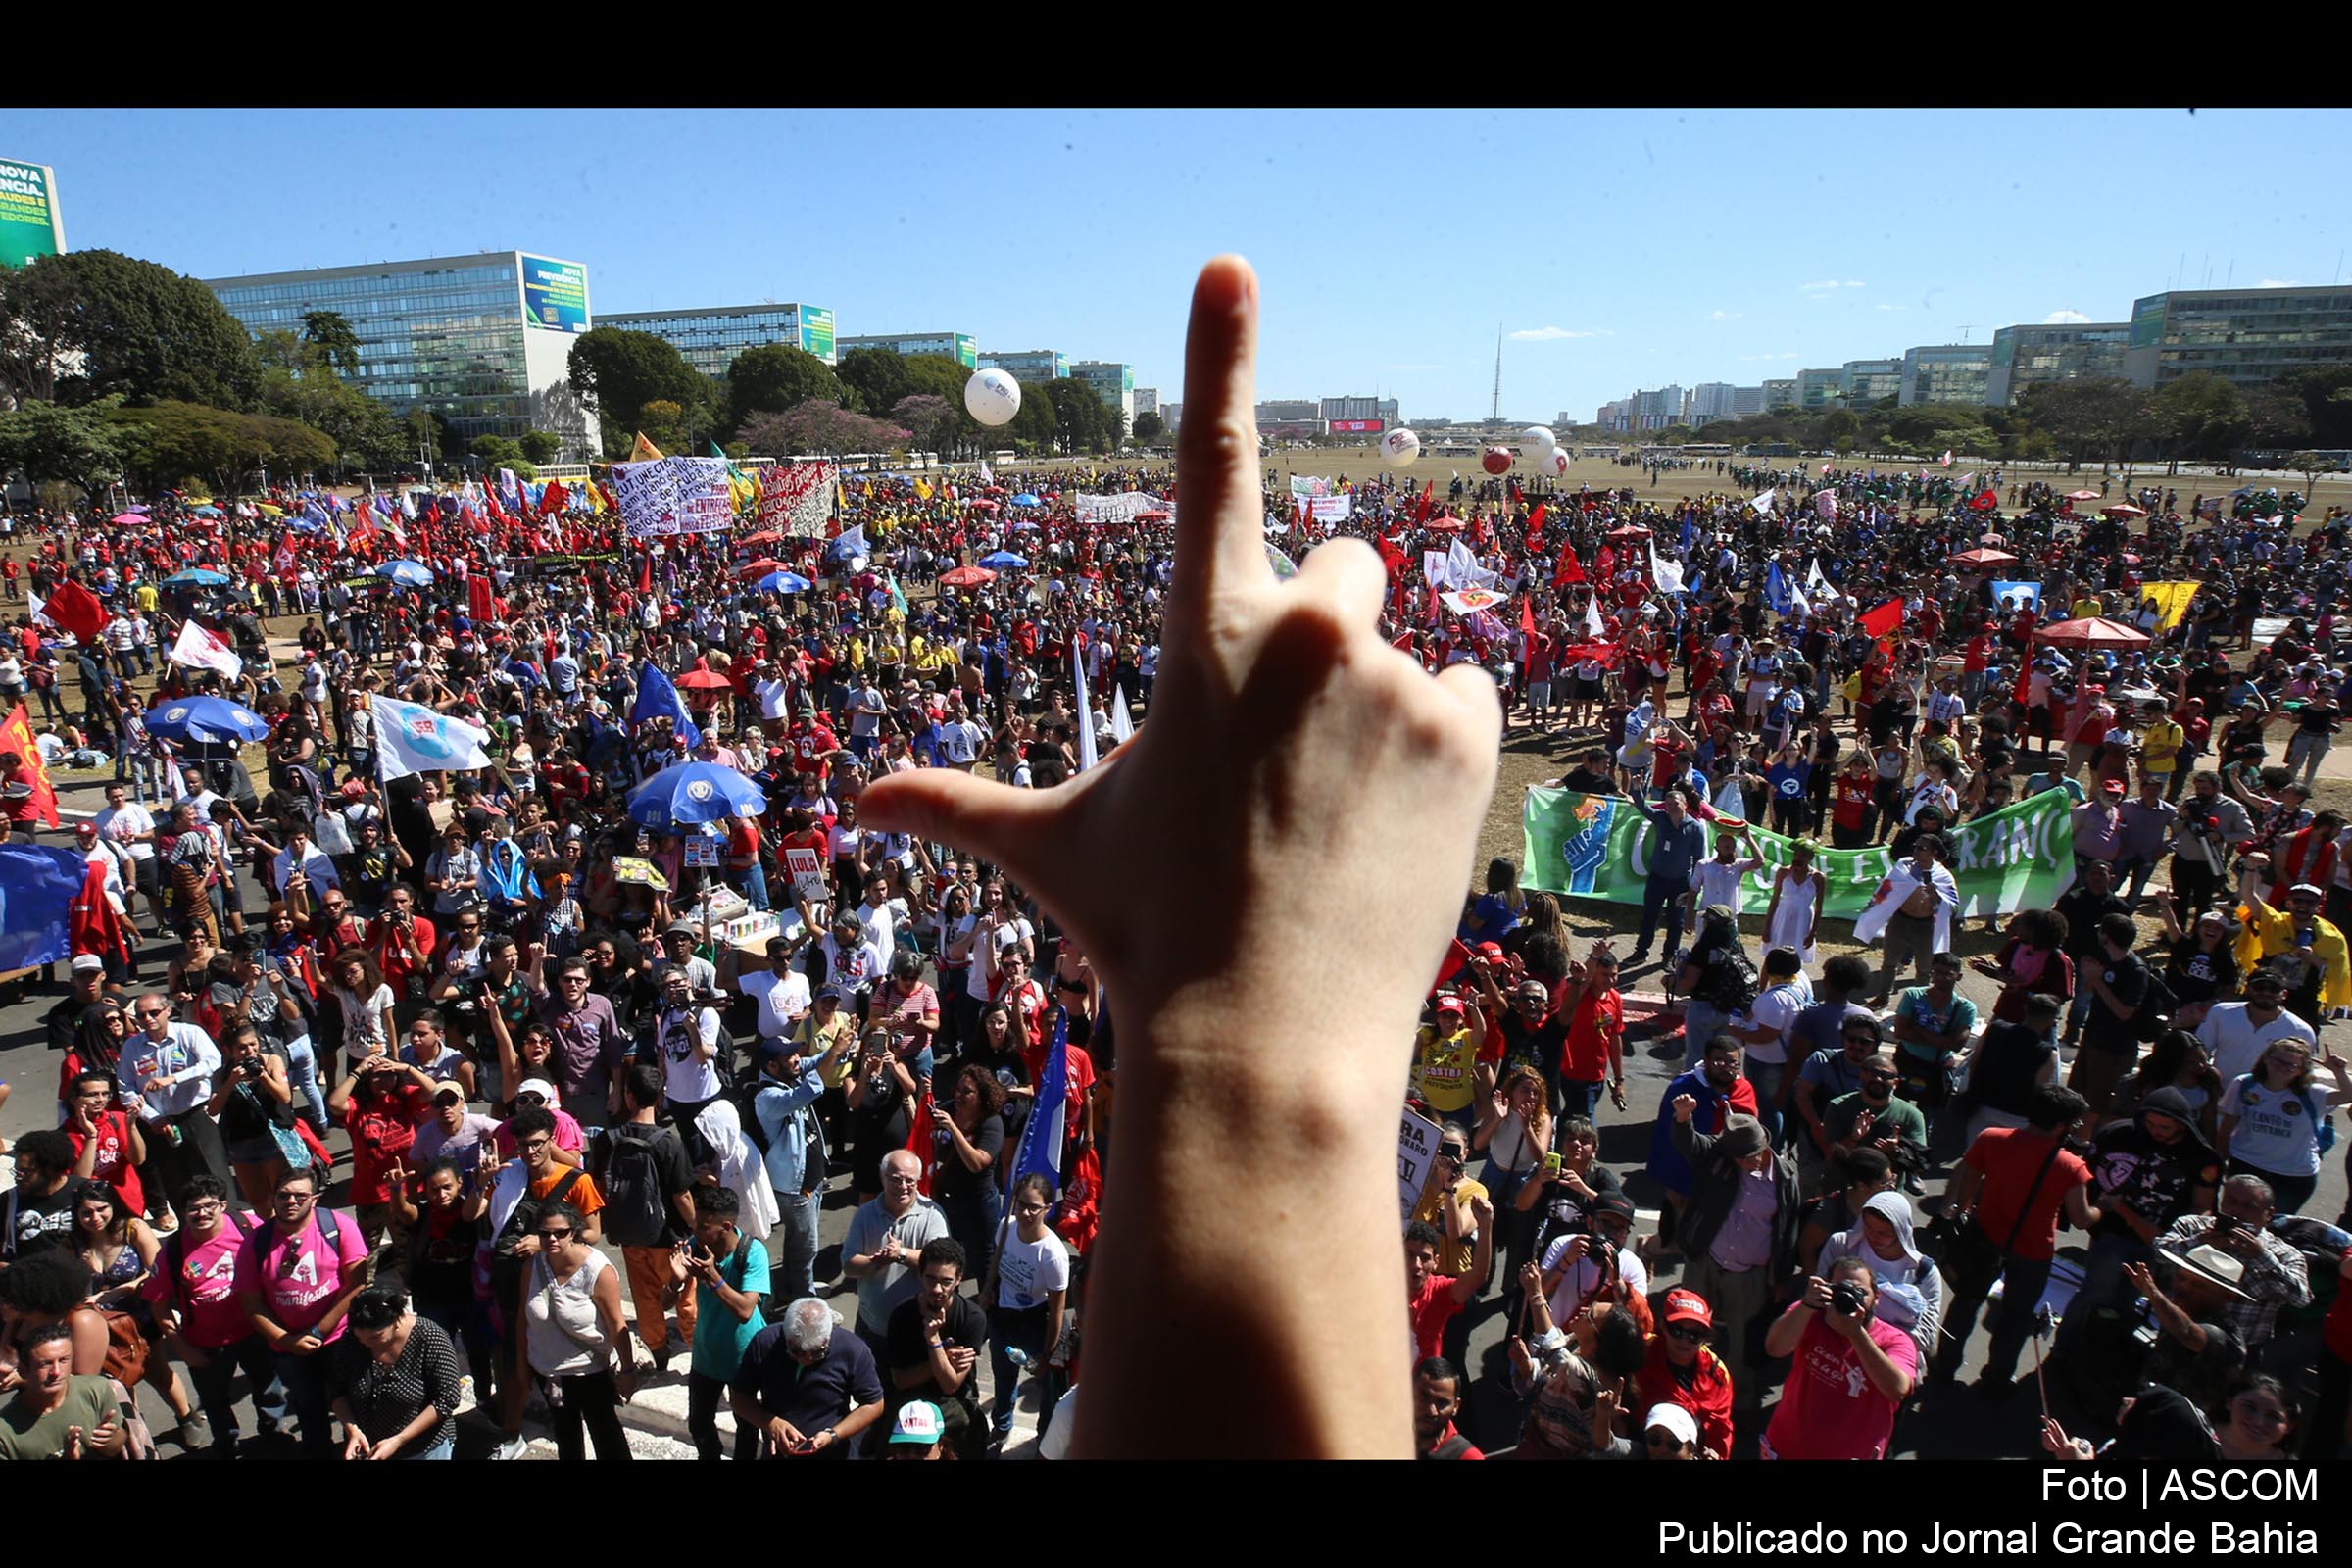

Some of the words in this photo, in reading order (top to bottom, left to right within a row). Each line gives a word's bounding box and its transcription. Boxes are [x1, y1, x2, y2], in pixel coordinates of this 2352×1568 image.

[0, 178, 45, 198] NCIA.
[0, 201, 48, 217] RANDES
[0, 212, 50, 226] EDORES.
[789, 857, 819, 872] LULA
[1424, 1065, 1463, 1077] CONTRA
[1400, 1119, 1425, 1146] RA
[1399, 1135, 1429, 1157] ONARO
